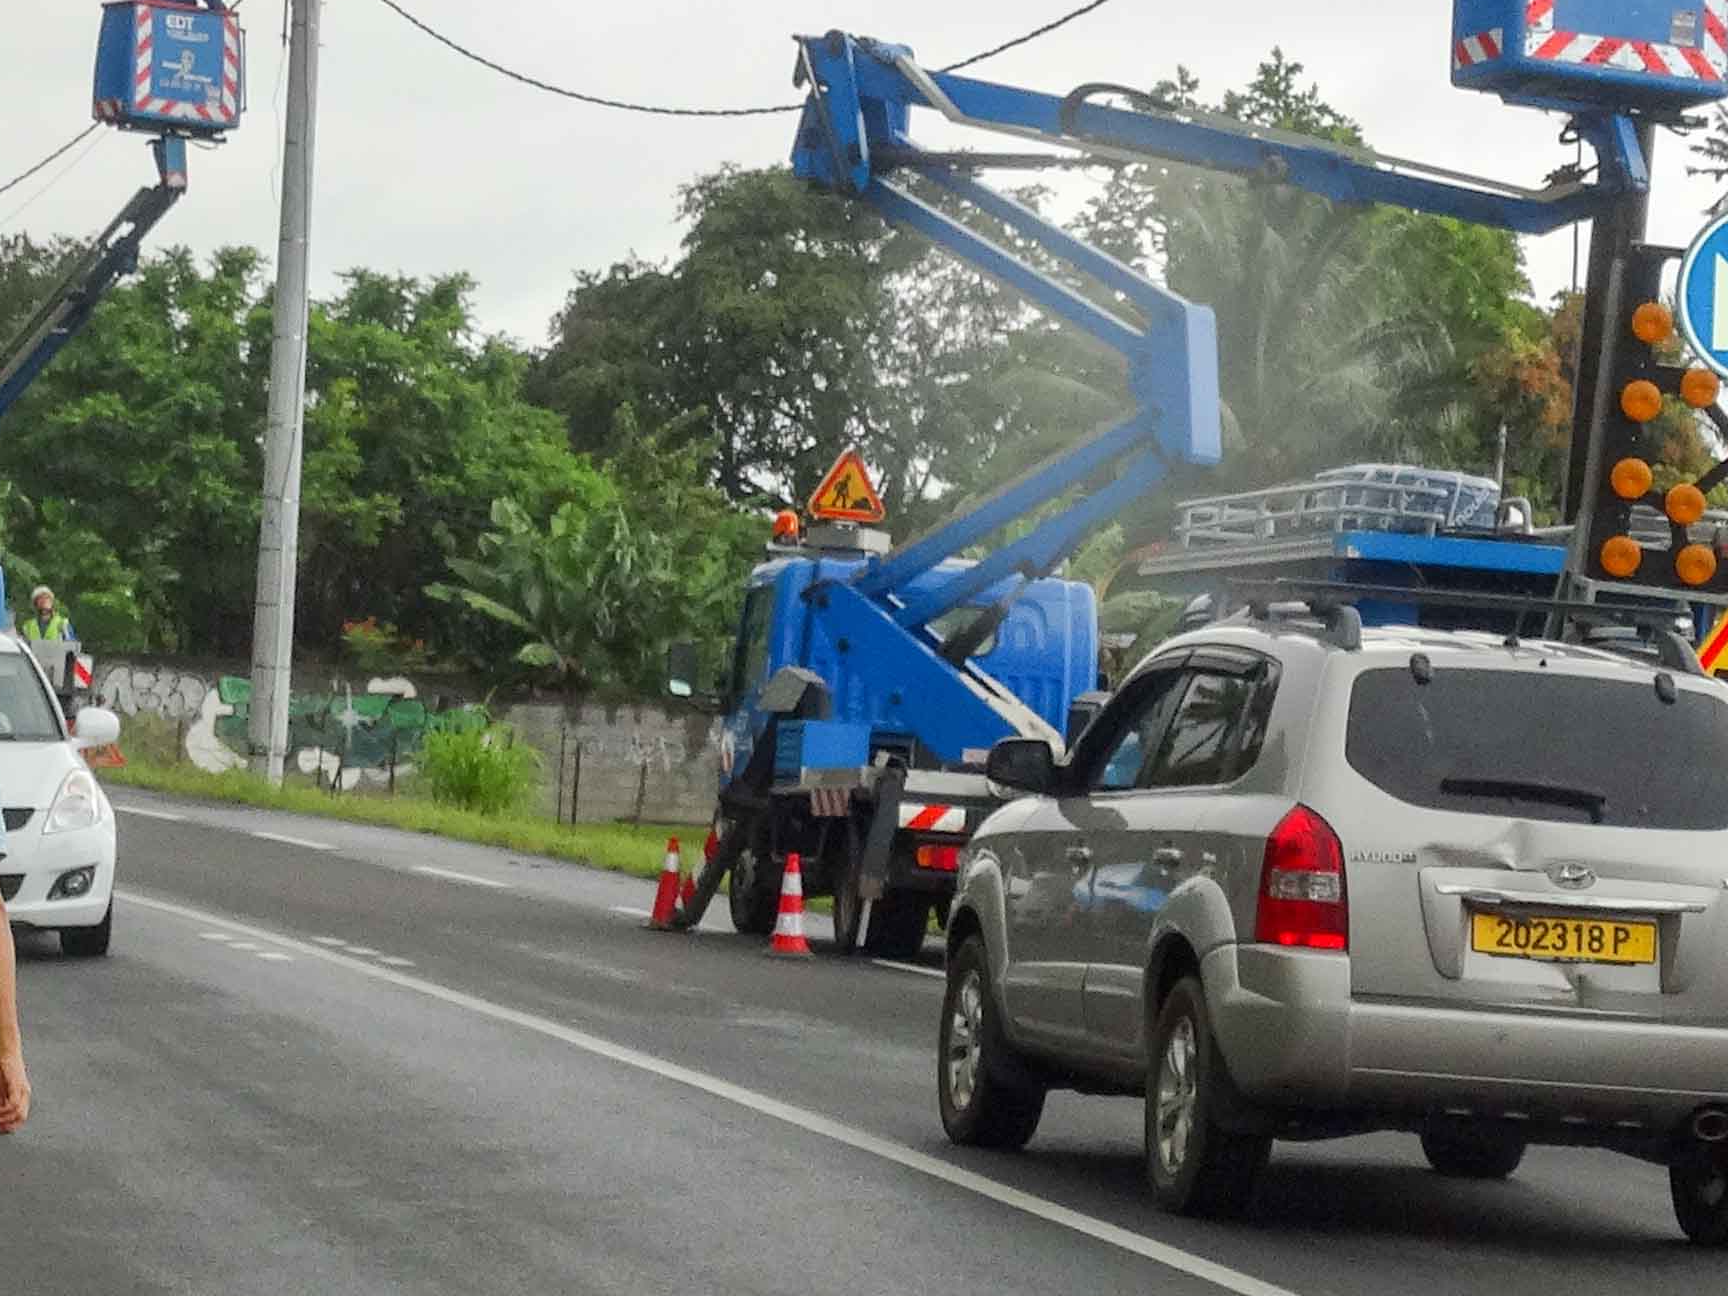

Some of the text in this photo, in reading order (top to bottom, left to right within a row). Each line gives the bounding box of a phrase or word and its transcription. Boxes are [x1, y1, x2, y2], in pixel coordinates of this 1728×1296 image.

[1350, 848, 1417, 864] HYUD
[1495, 917, 1631, 955] 202318 P
